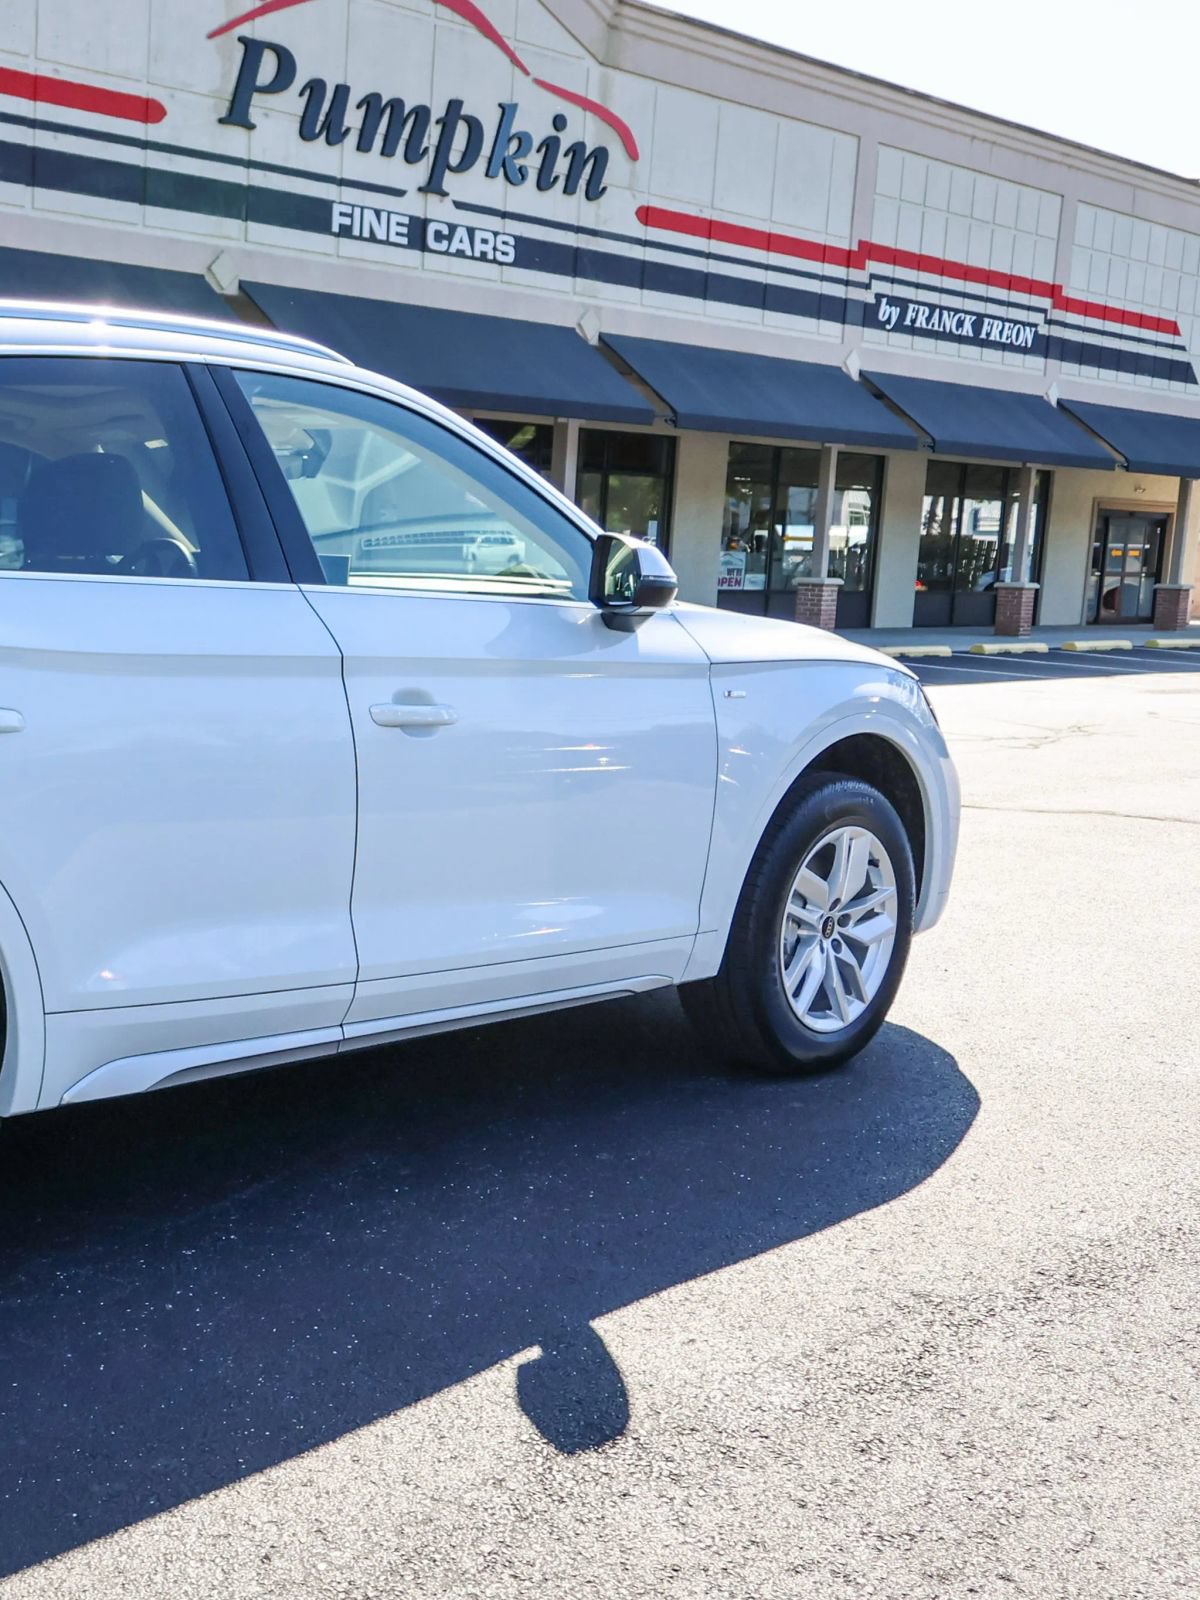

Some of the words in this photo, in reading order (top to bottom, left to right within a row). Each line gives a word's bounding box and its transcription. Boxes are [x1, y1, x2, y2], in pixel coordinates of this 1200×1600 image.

[217, 35, 610, 201] Pumpkin
[331, 203, 409, 246] FINE
[427, 222, 516, 264] CARS
[877, 297, 901, 330] by
[903, 303, 977, 337] FRANCK
[979, 317, 1036, 349] FREON
